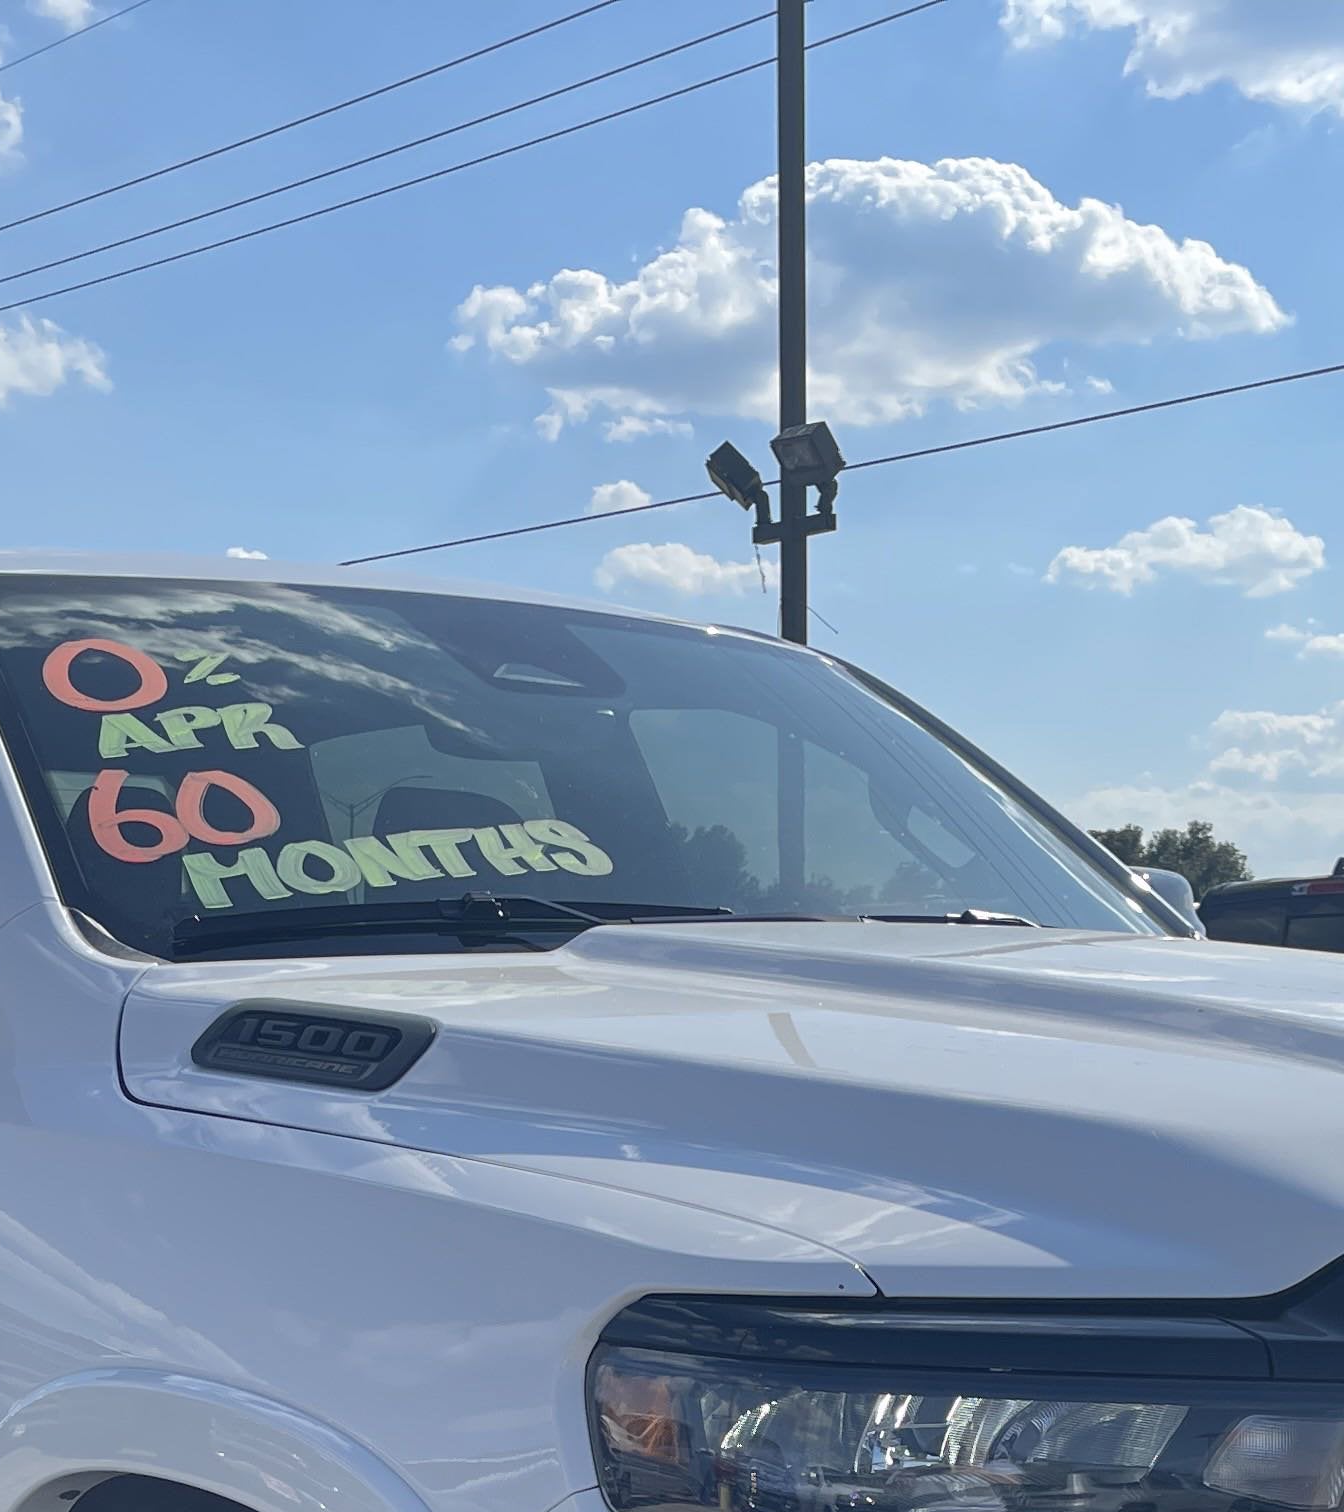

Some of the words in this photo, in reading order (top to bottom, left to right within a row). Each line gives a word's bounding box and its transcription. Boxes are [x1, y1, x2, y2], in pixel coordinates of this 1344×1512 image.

[98, 702, 304, 758] APR
[88, 769, 281, 863] 60
[180, 819, 613, 909] MONTHS
[237, 1018, 391, 1057] 1500
